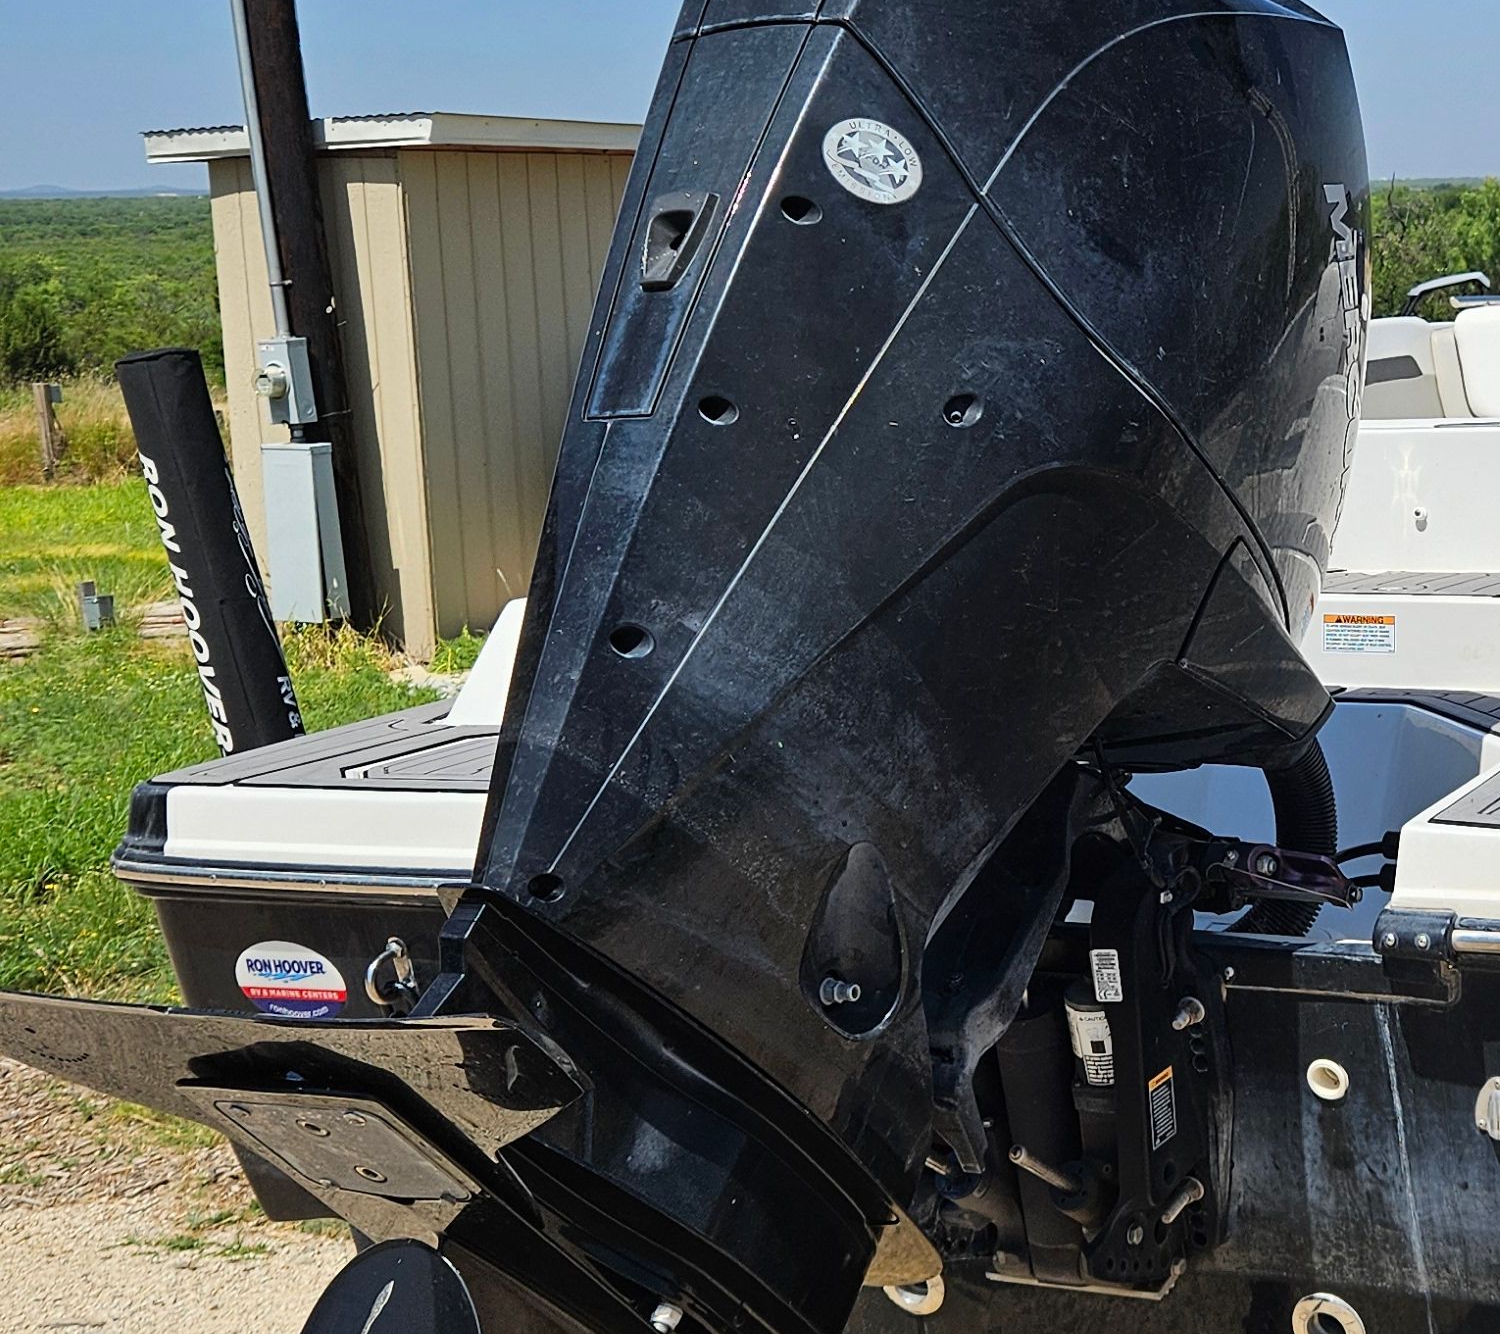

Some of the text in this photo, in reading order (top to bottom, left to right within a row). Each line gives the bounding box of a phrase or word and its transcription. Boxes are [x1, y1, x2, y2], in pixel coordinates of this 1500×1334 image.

[848, 122, 918, 167] ULTRA LOW
[138, 452, 234, 754] RON HOOVER
[1343, 615, 1384, 624] WARNING
[277, 675, 302, 730] RV &
[245, 958, 325, 974] RON HOOVER
[269, 989, 301, 999] MARINE
[302, 990, 339, 1000] CENTERS
[269, 1003, 329, 1019] ronhoover.com
